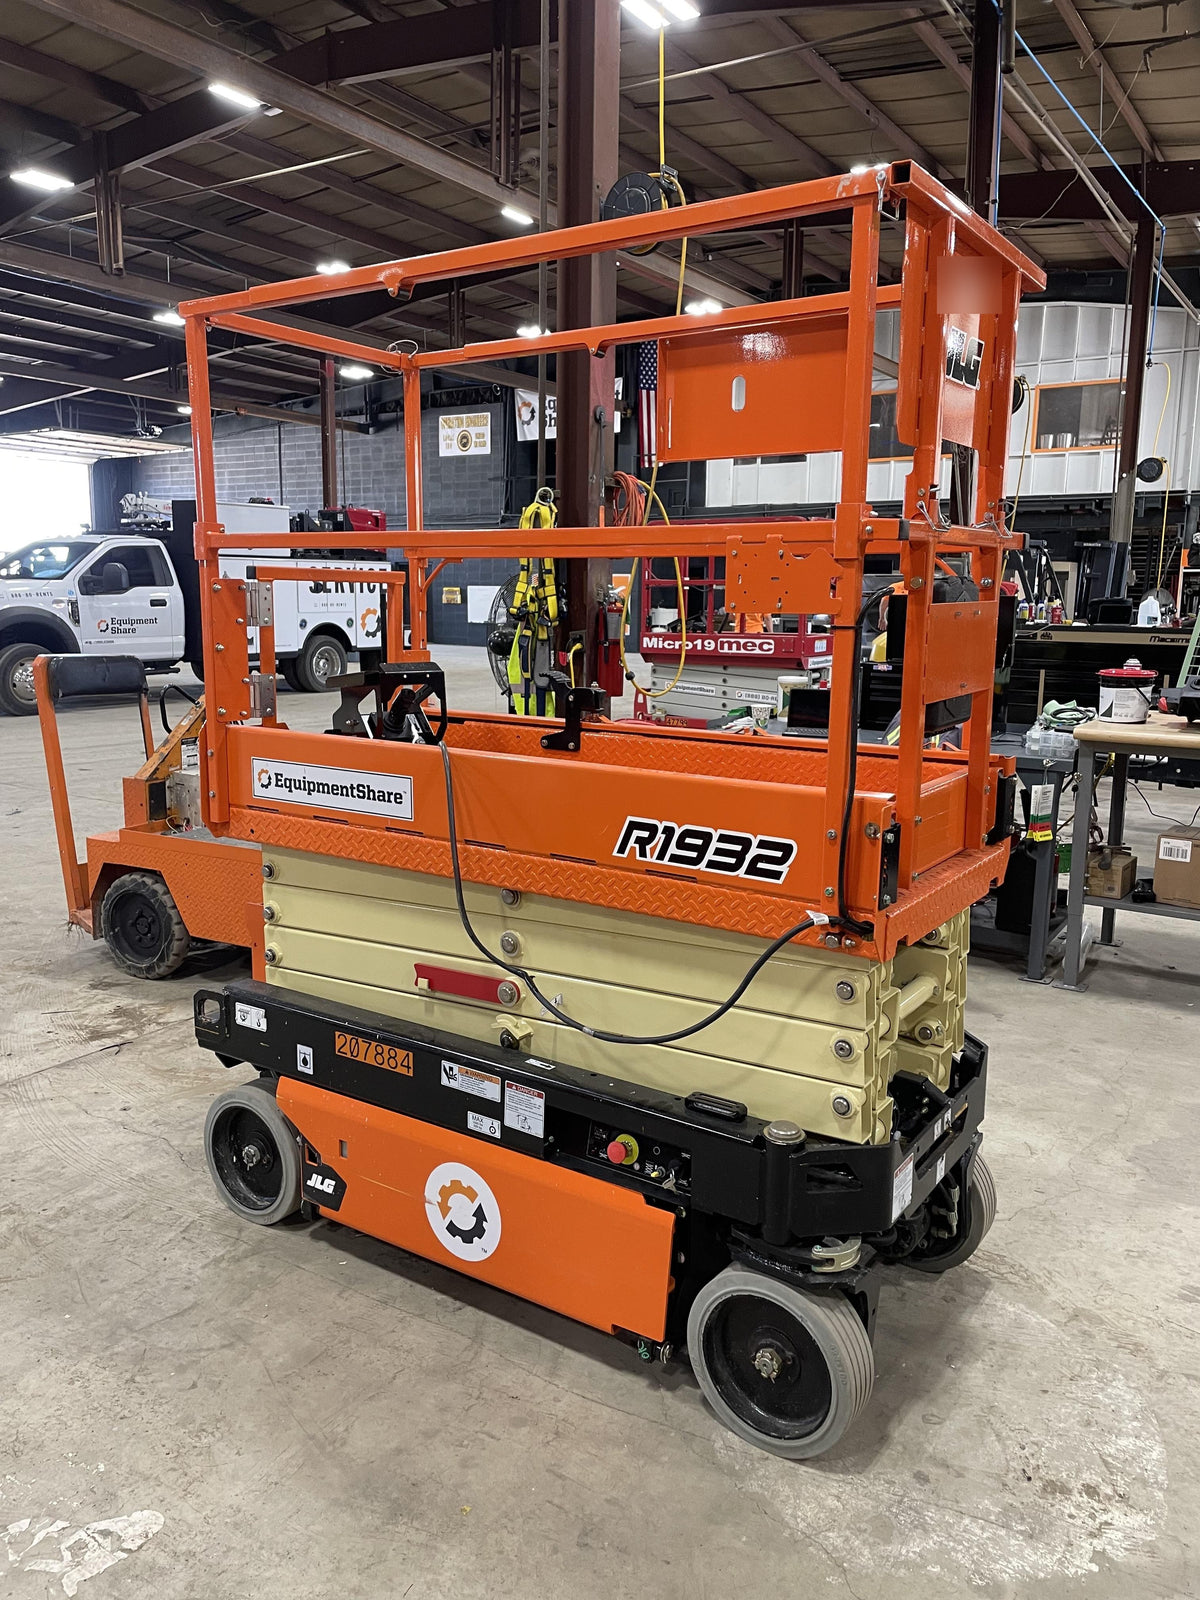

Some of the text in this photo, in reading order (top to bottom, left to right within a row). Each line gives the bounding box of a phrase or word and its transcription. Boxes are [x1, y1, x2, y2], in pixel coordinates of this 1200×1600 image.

[110, 617, 158, 627] Equipment
[110, 626, 137, 635] Share
[642, 636, 774, 653] Micro19 mec
[274, 772, 404, 805] EquipmentShare
[614, 818, 796, 883] R1932
[337, 1033, 412, 1074] 207884
[517, 1086, 538, 1097] DANGER
[471, 1114, 484, 1124] MAX
[306, 1173, 336, 1194] JLG
